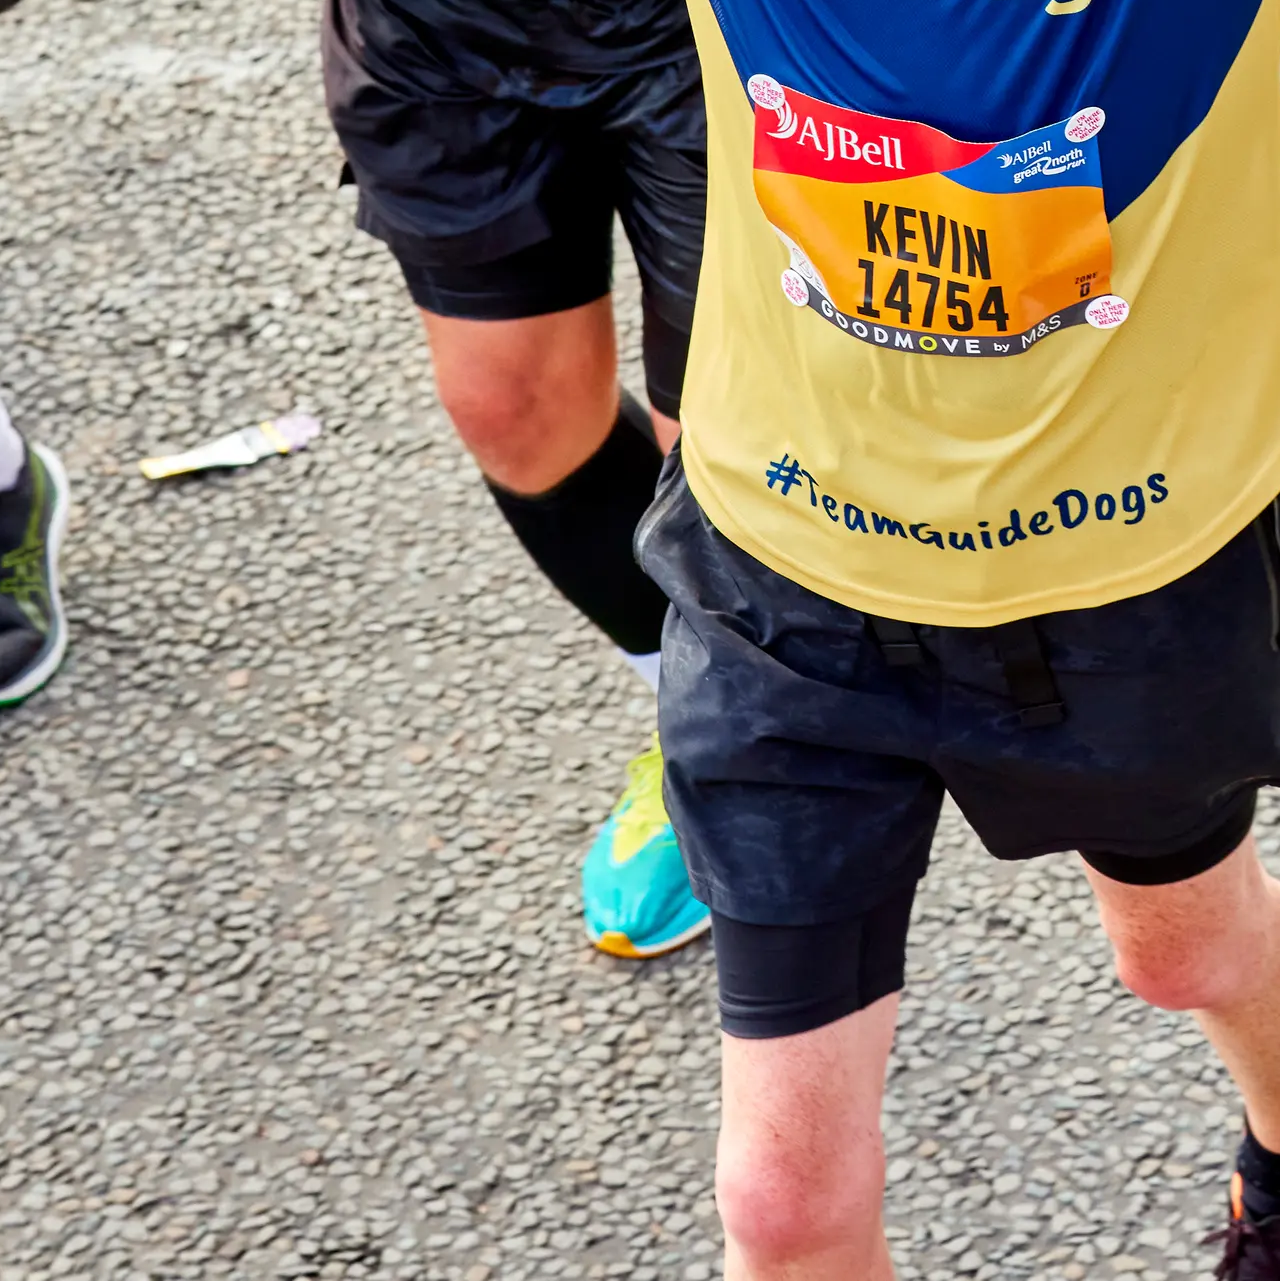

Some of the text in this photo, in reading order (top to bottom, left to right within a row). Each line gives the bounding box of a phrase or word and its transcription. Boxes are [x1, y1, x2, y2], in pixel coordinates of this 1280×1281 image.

[796, 116, 906, 170] AJBell
[1012, 140, 1052, 165] AJBell
[1013, 148, 1083, 184] great north
[1066, 158, 1086, 170] run
[863, 200, 992, 280] KEVIN
[856, 258, 1010, 332] 14754
[1075, 271, 1098, 285] ZONE
[820, 298, 1062, 354] GOODMOVE by M&S
[765, 453, 1169, 552] #TeamGuideDogs
